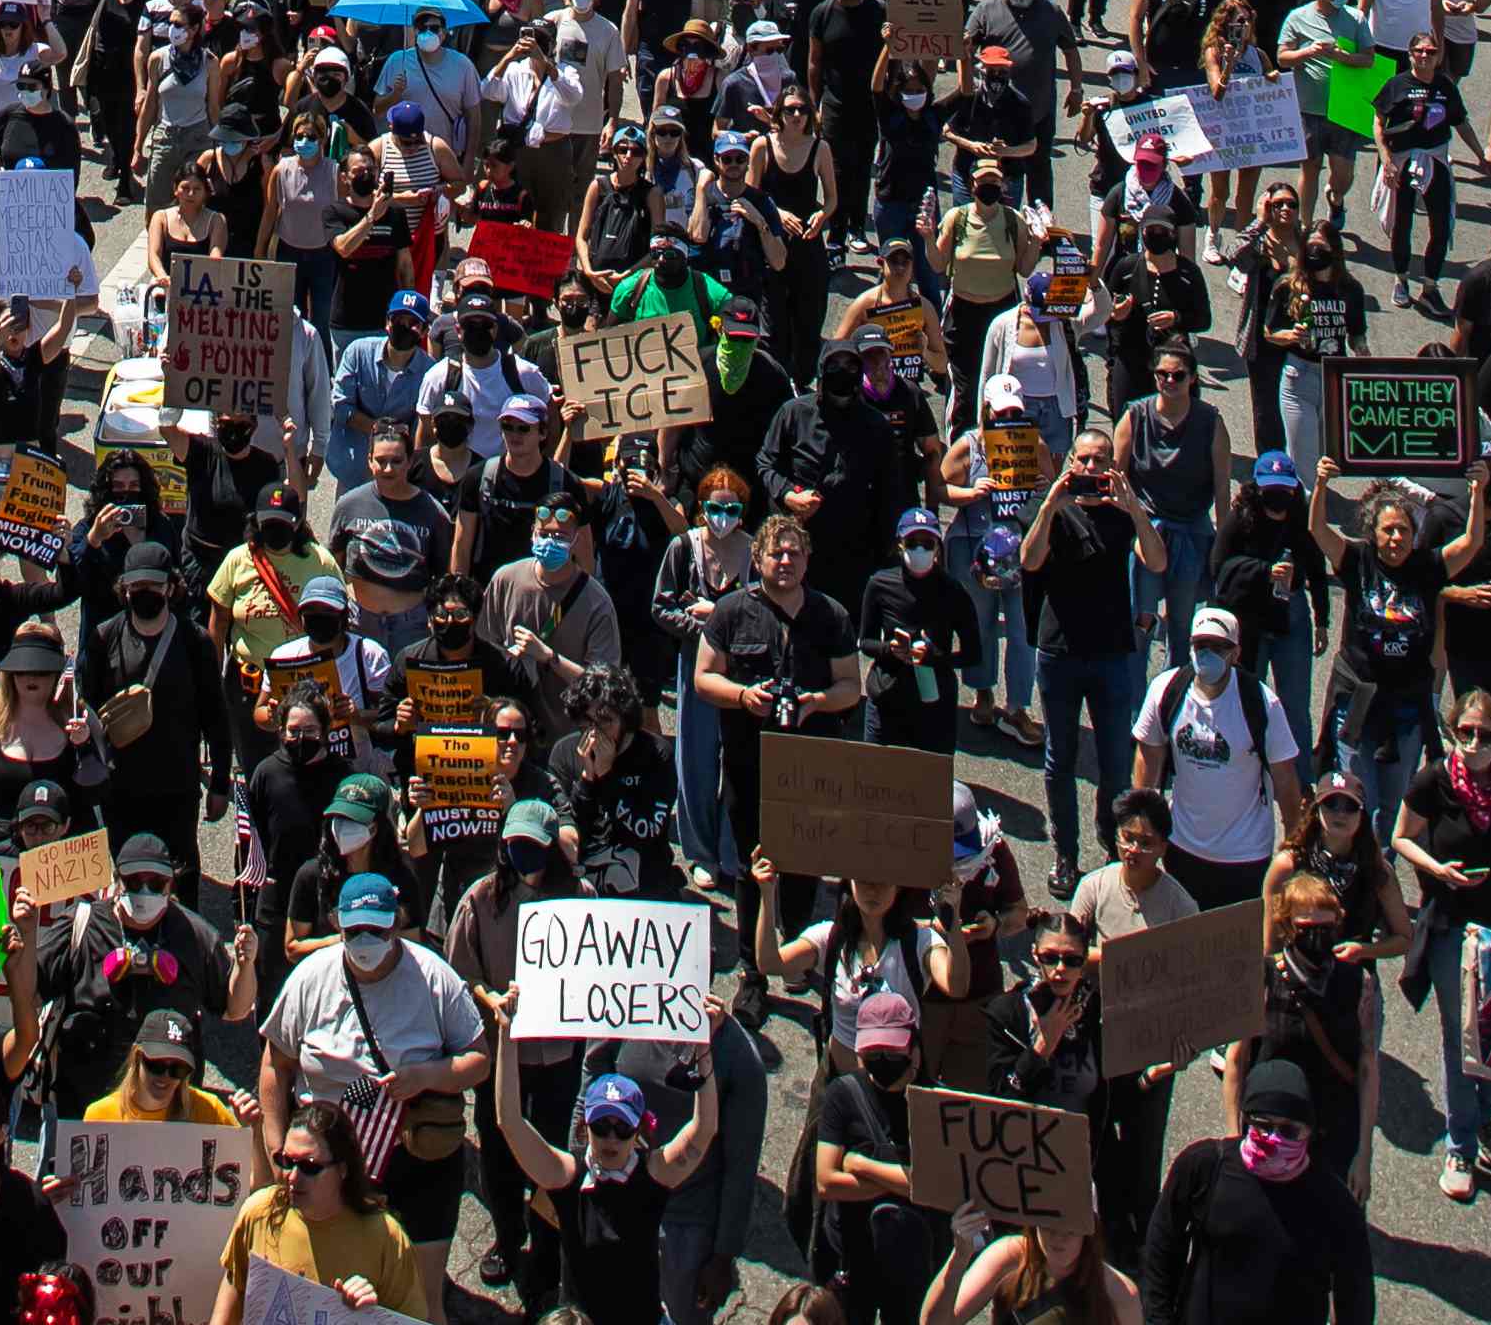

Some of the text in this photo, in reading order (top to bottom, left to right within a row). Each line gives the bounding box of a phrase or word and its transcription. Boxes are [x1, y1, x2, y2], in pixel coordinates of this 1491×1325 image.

[893, 29, 952, 57] STASI
[1125, 108, 1168, 125] UNITED
[7, 229, 55, 253] ESTAR
[0, 252, 59, 277] UNIDAS
[180, 260, 263, 307] LA IS
[231, 288, 273, 311] THE
[177, 310, 279, 343] MELTING
[200, 348, 275, 379] POINT
[573, 323, 697, 383] FUCK
[184, 377, 274, 411] OF ICE
[594, 375, 693, 428] ICE
[1349, 380, 1456, 404] THEN THEY
[1349, 406, 1456, 428] CAME FOR
[994, 444, 1035, 455] Trump
[35, 460, 56, 477] The
[21, 472, 61, 495] Trump
[992, 491, 1028, 502] MUST
[41, 534, 63, 549] GO
[1383, 641, 1409, 654] KRC
[442, 738, 470, 752] The
[426, 754, 484, 771] Trump
[426, 771, 493, 786] Fascist
[423, 808, 500, 824] MUST GO
[432, 821, 498, 841] NOW!!!
[38, 834, 99, 864] GO HOME
[35, 853, 103, 895] NAZIS
[522, 911, 691, 978] GO AWAY
[559, 978, 701, 1031] LOSERS
[939, 1100, 1066, 1173] FUCK
[70, 1133, 241, 1207] Hands
[959, 1153, 1062, 1218] ICE
[102, 1216, 169, 1250] OFF
